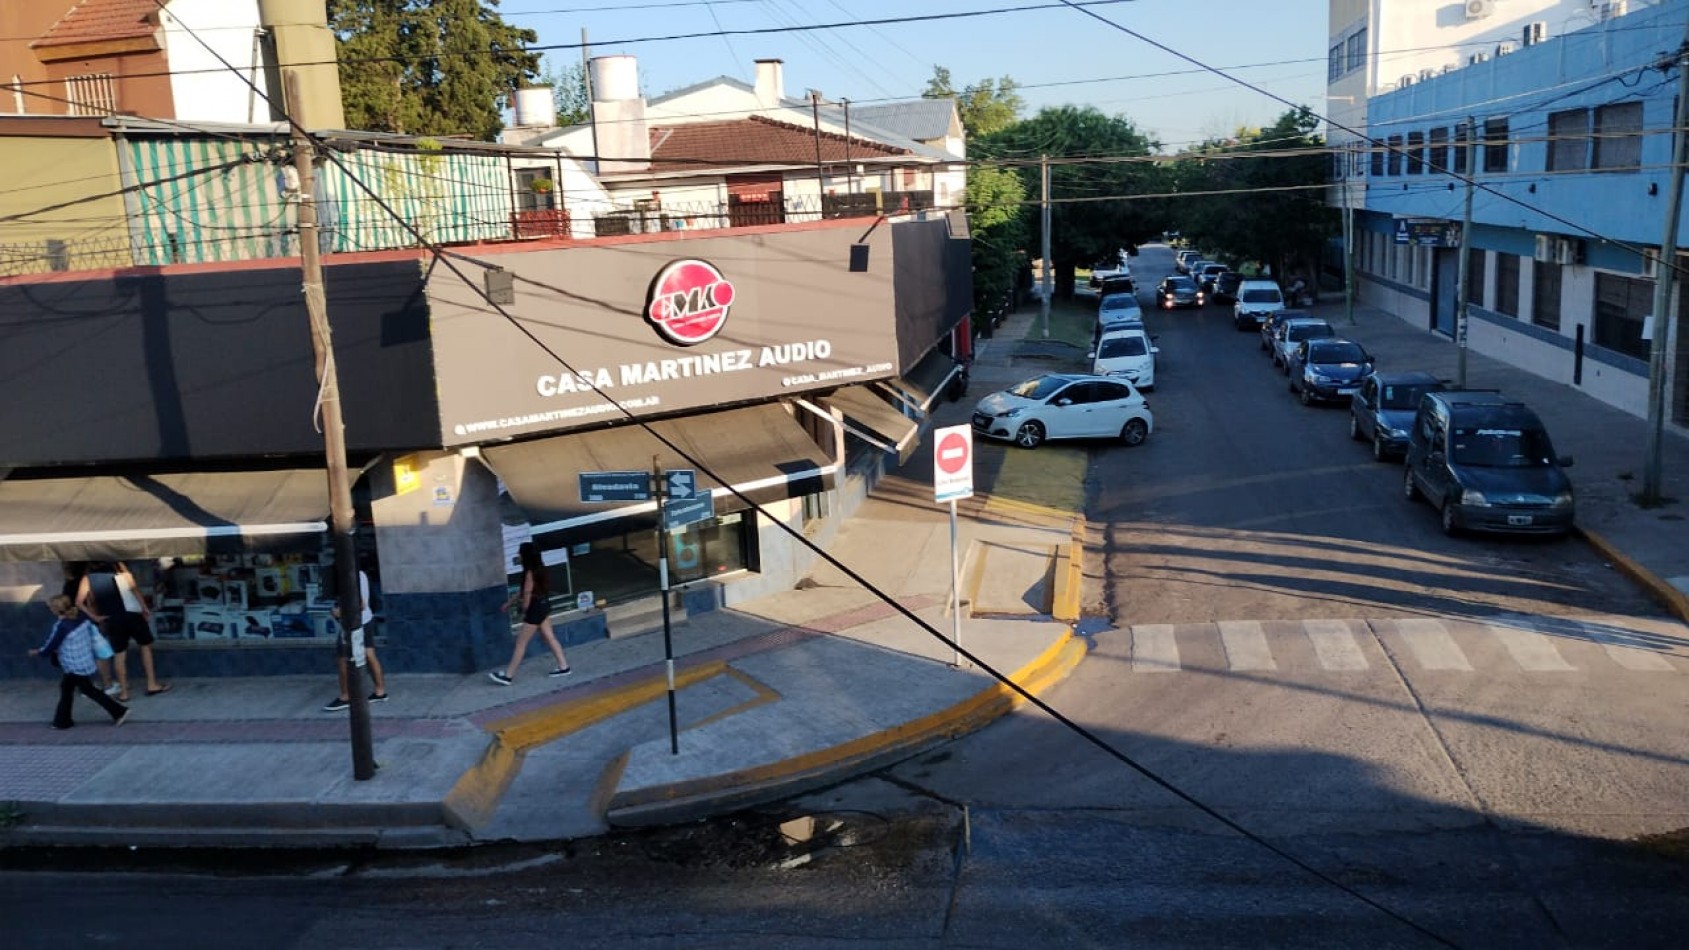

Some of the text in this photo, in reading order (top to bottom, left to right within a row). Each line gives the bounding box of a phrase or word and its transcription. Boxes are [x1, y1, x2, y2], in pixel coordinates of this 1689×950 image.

[537, 339, 831, 397] CASA MARTINEZ AUDIO
